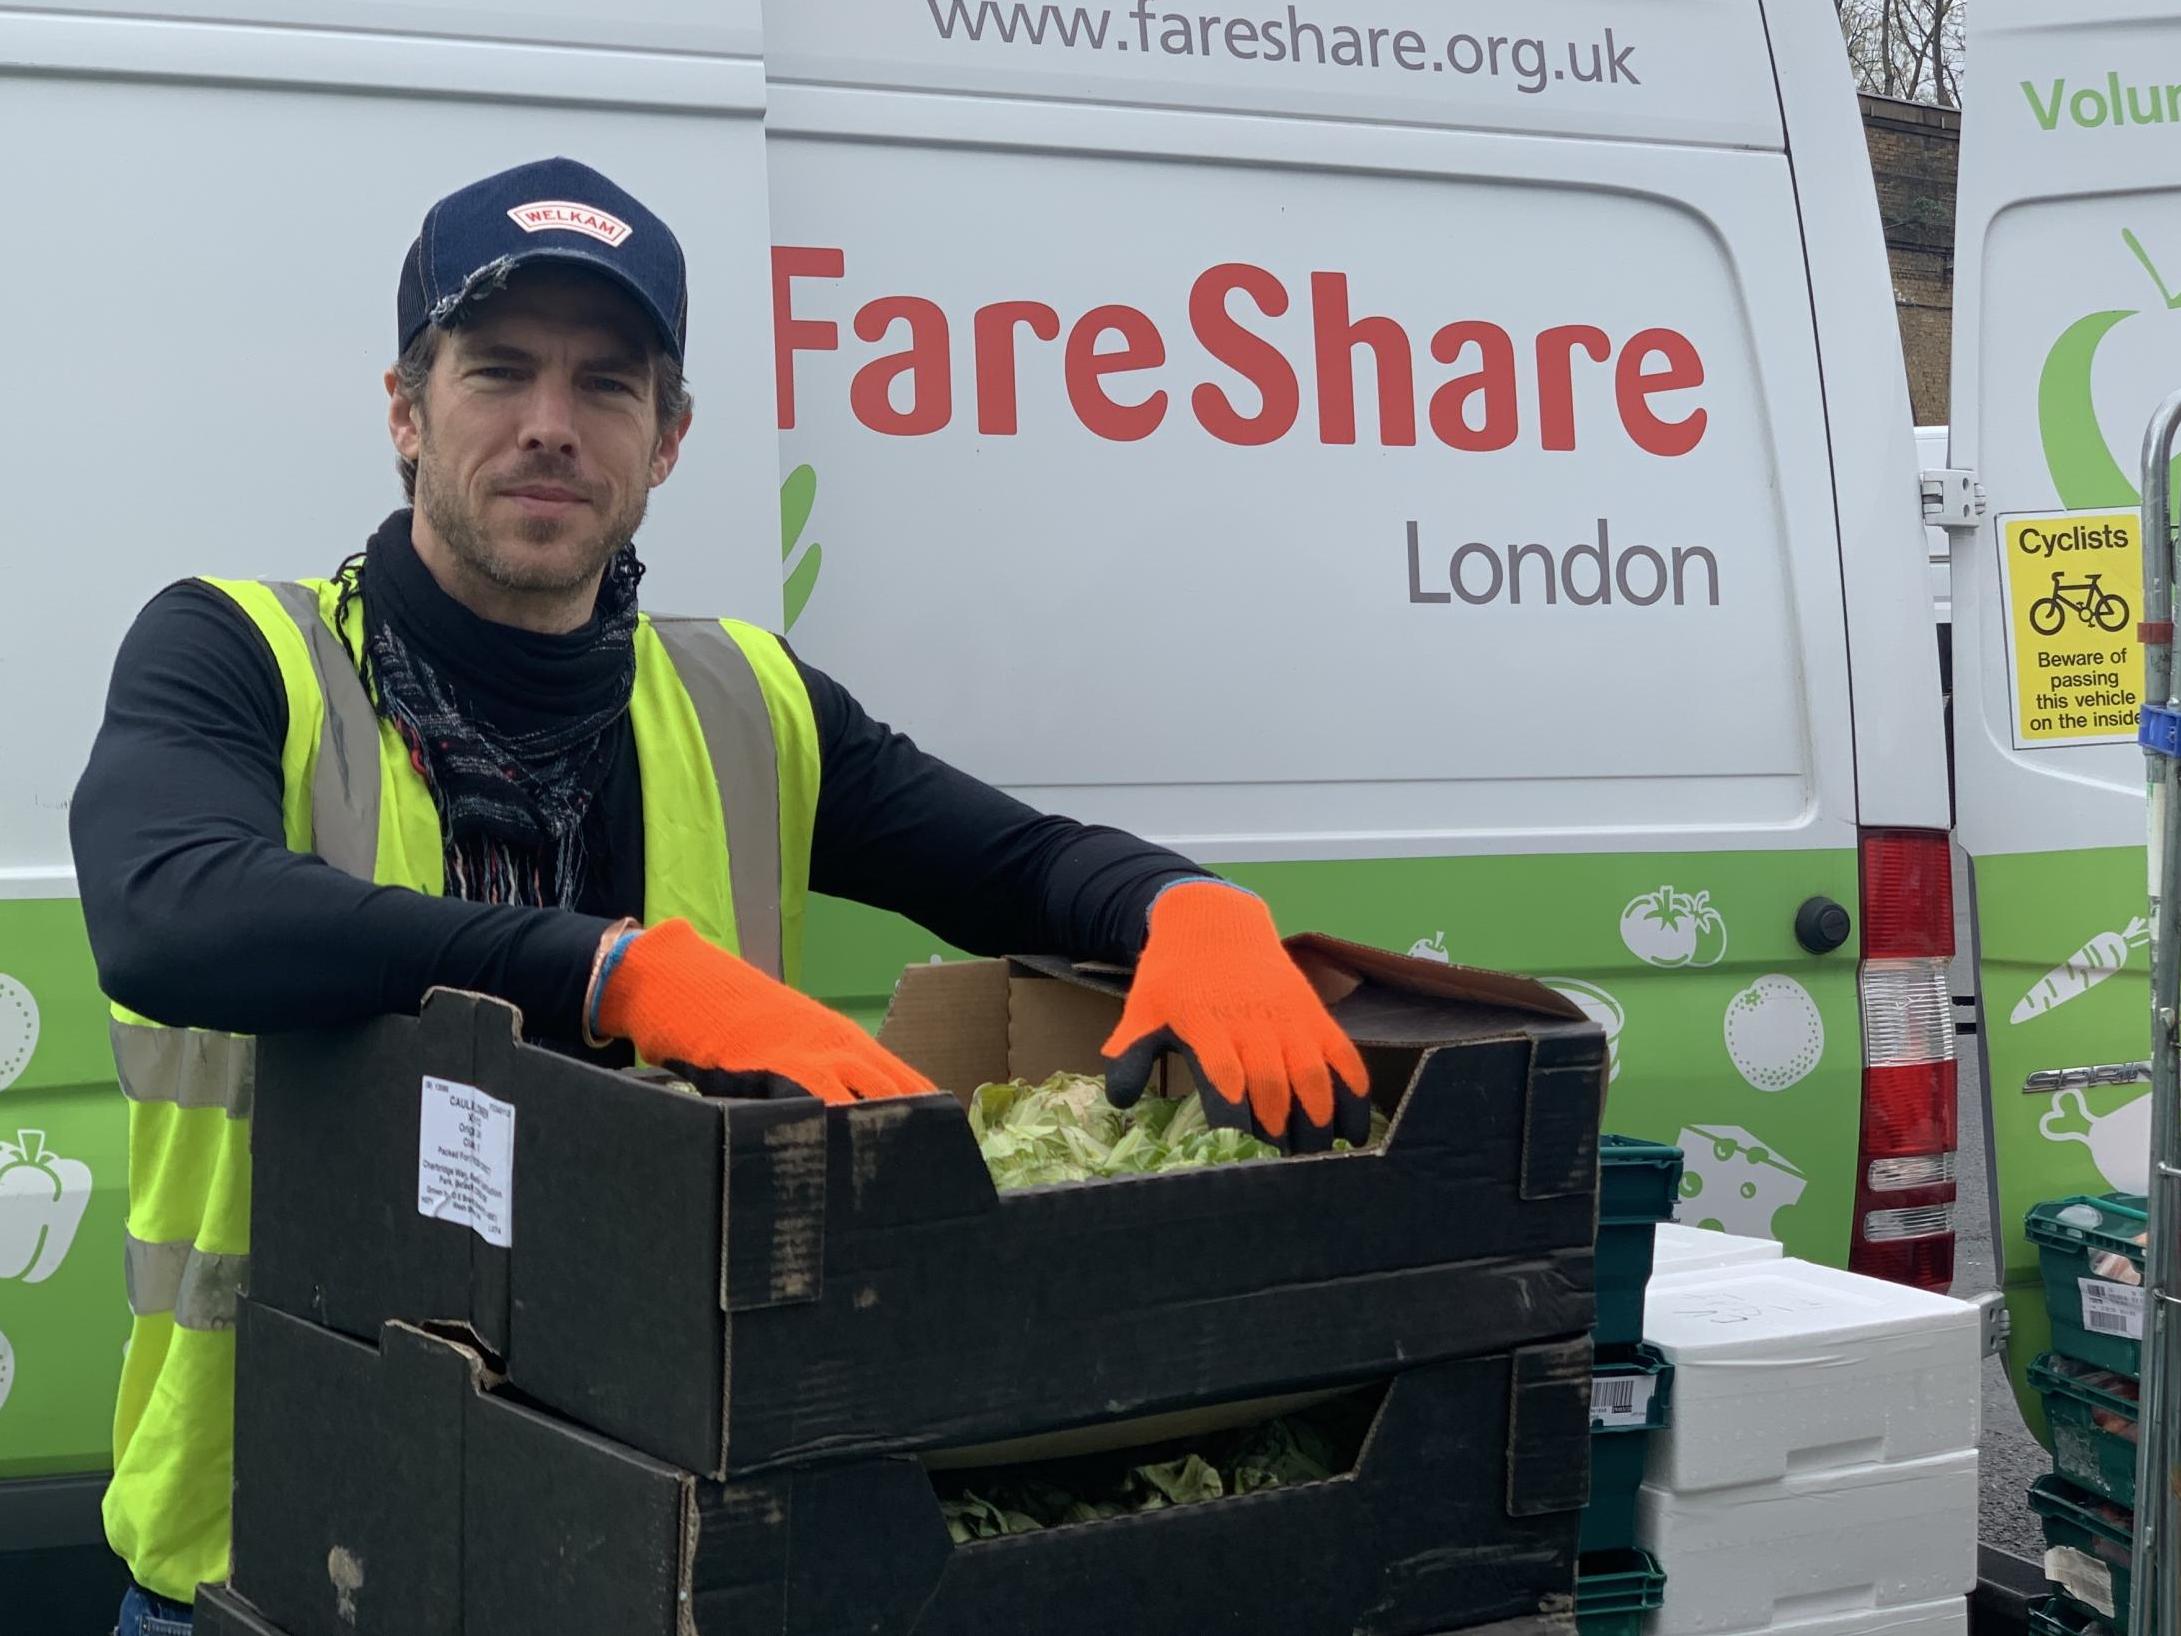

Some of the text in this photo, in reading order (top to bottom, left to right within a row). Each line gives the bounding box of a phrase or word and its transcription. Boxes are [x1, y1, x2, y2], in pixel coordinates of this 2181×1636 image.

[928, 0, 1641, 93] www.fareshare.org.uk
[525, 210, 616, 236] WELKAM
[772, 247, 1707, 456] FareShare
[2019, 524, 2129, 558] Cyclists
[1407, 519, 1720, 607] London
[2038, 648, 2128, 668] Beware of
[2050, 671, 2119, 692] passing
[2036, 689, 2136, 710] this vehicle
[2030, 709, 2141, 731] on the inside
